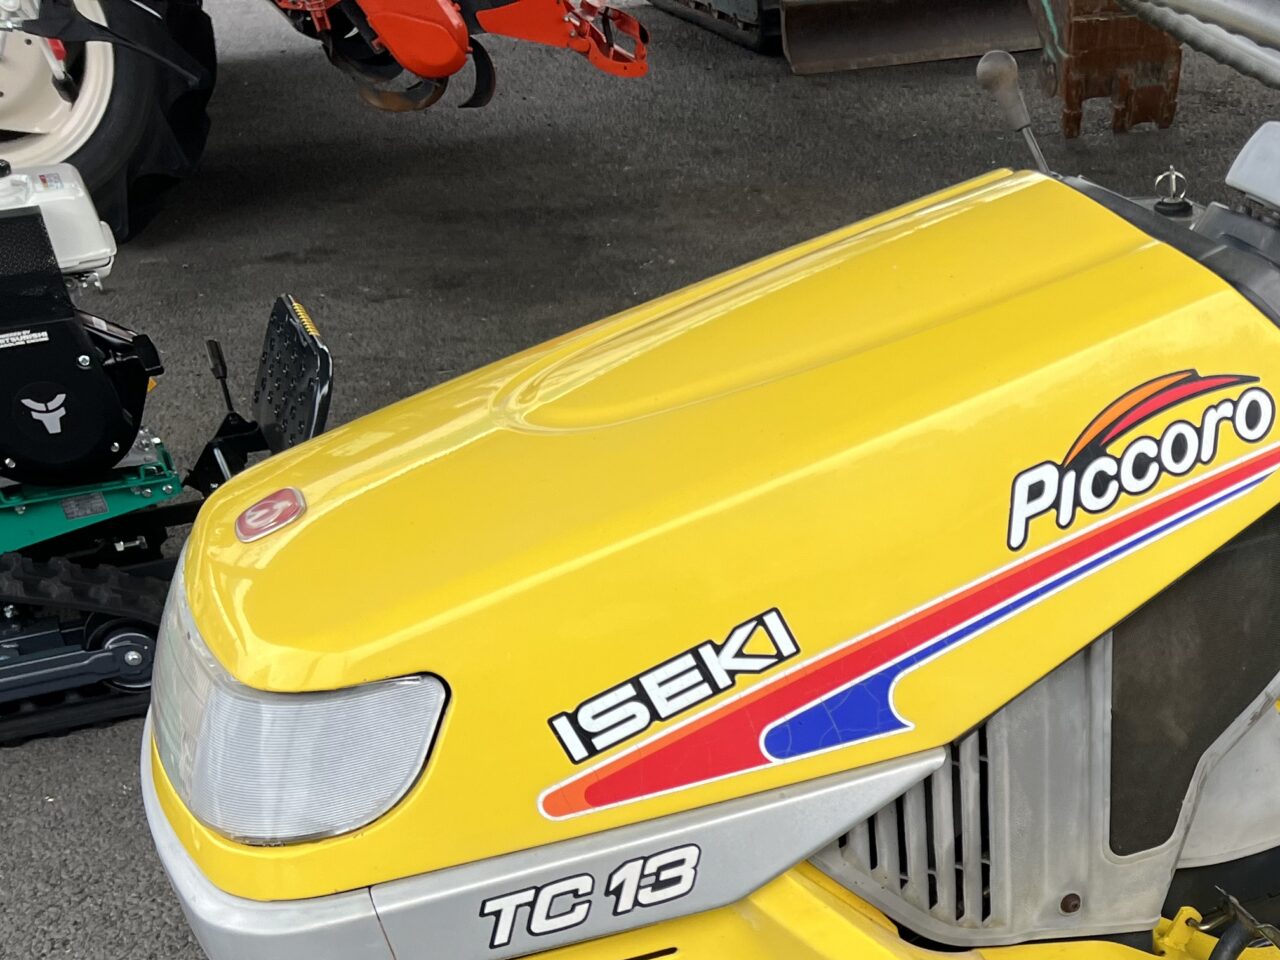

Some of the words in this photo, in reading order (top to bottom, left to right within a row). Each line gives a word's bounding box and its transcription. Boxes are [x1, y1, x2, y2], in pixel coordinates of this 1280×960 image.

[1008, 387, 1276, 551] Piccoro
[548, 608, 802, 763] ISEKI
[479, 872, 596, 950] TC
[604, 843, 702, 916] 13
